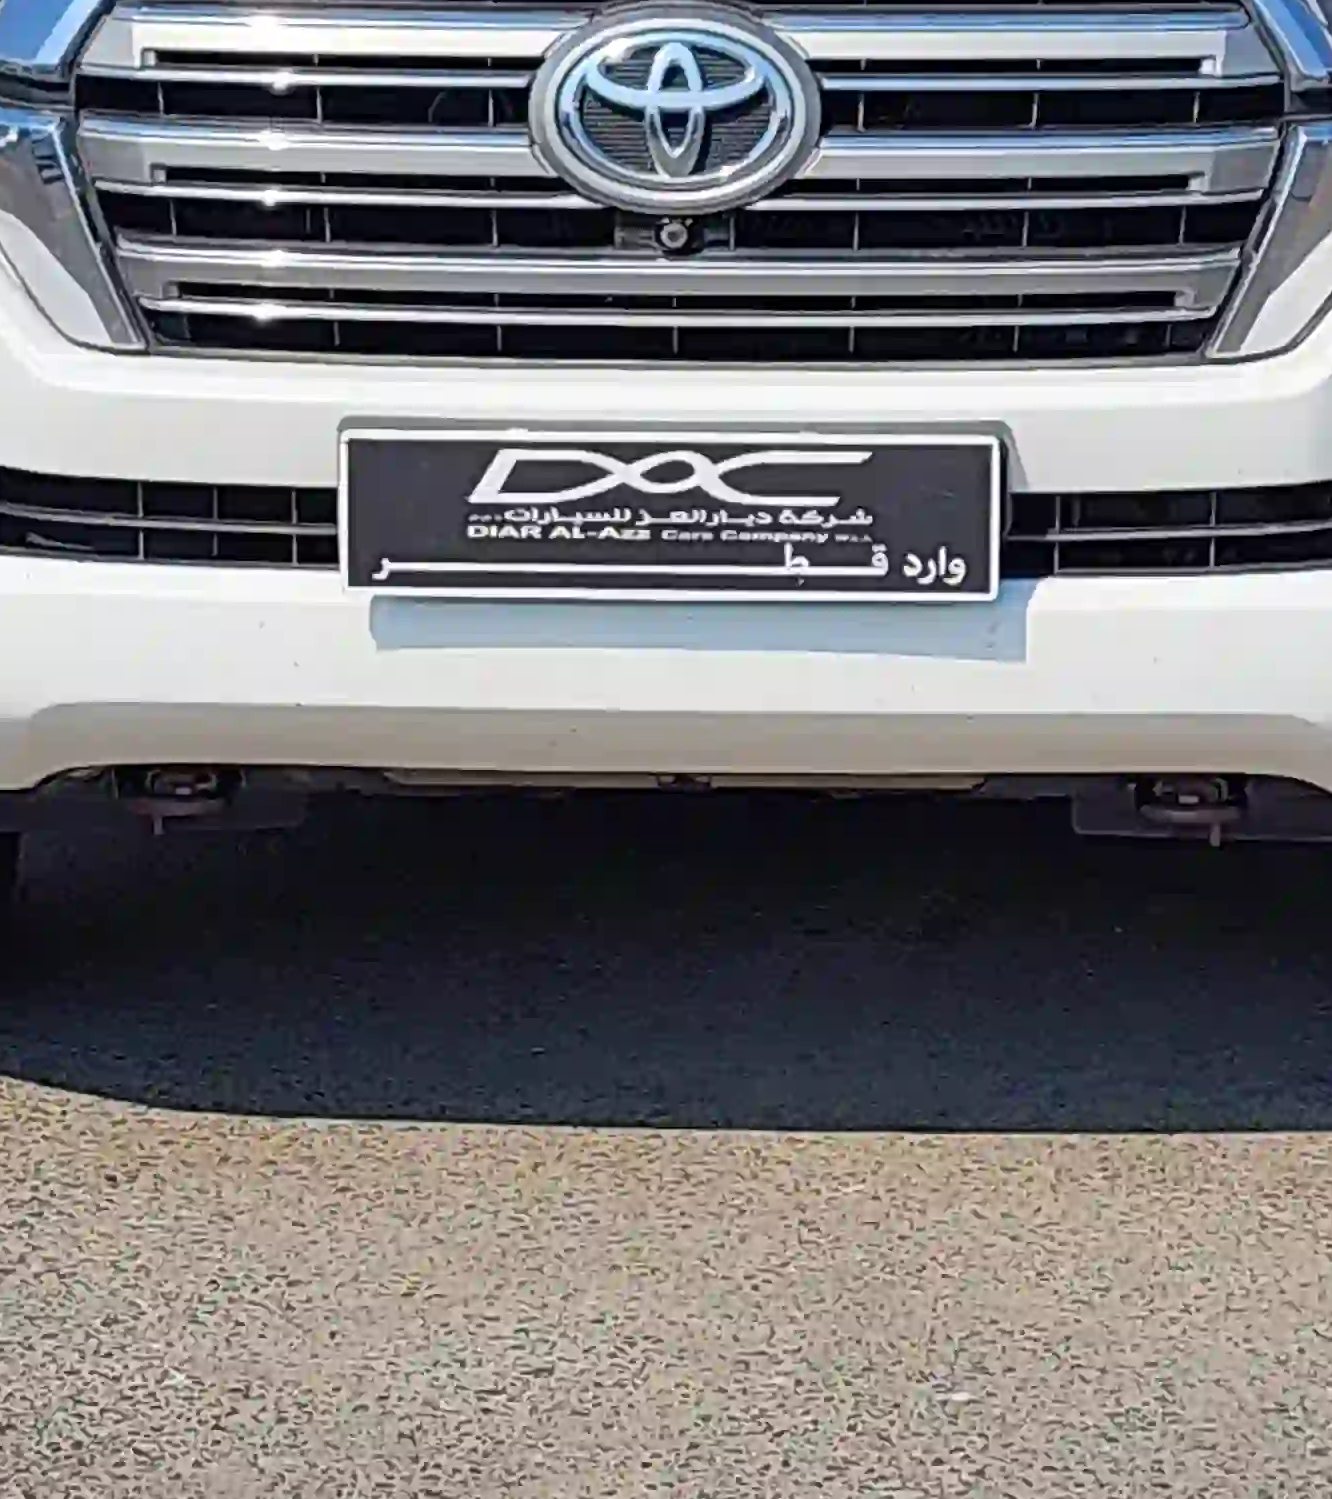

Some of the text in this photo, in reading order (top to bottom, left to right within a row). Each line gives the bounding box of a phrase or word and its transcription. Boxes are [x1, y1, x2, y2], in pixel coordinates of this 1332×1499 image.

[778, 506, 873, 528] شركة
[467, 526, 542, 540] DIAR
[661, 529, 714, 541] Cars
[719, 529, 829, 544] Company
[903, 547, 967, 584] وارد
